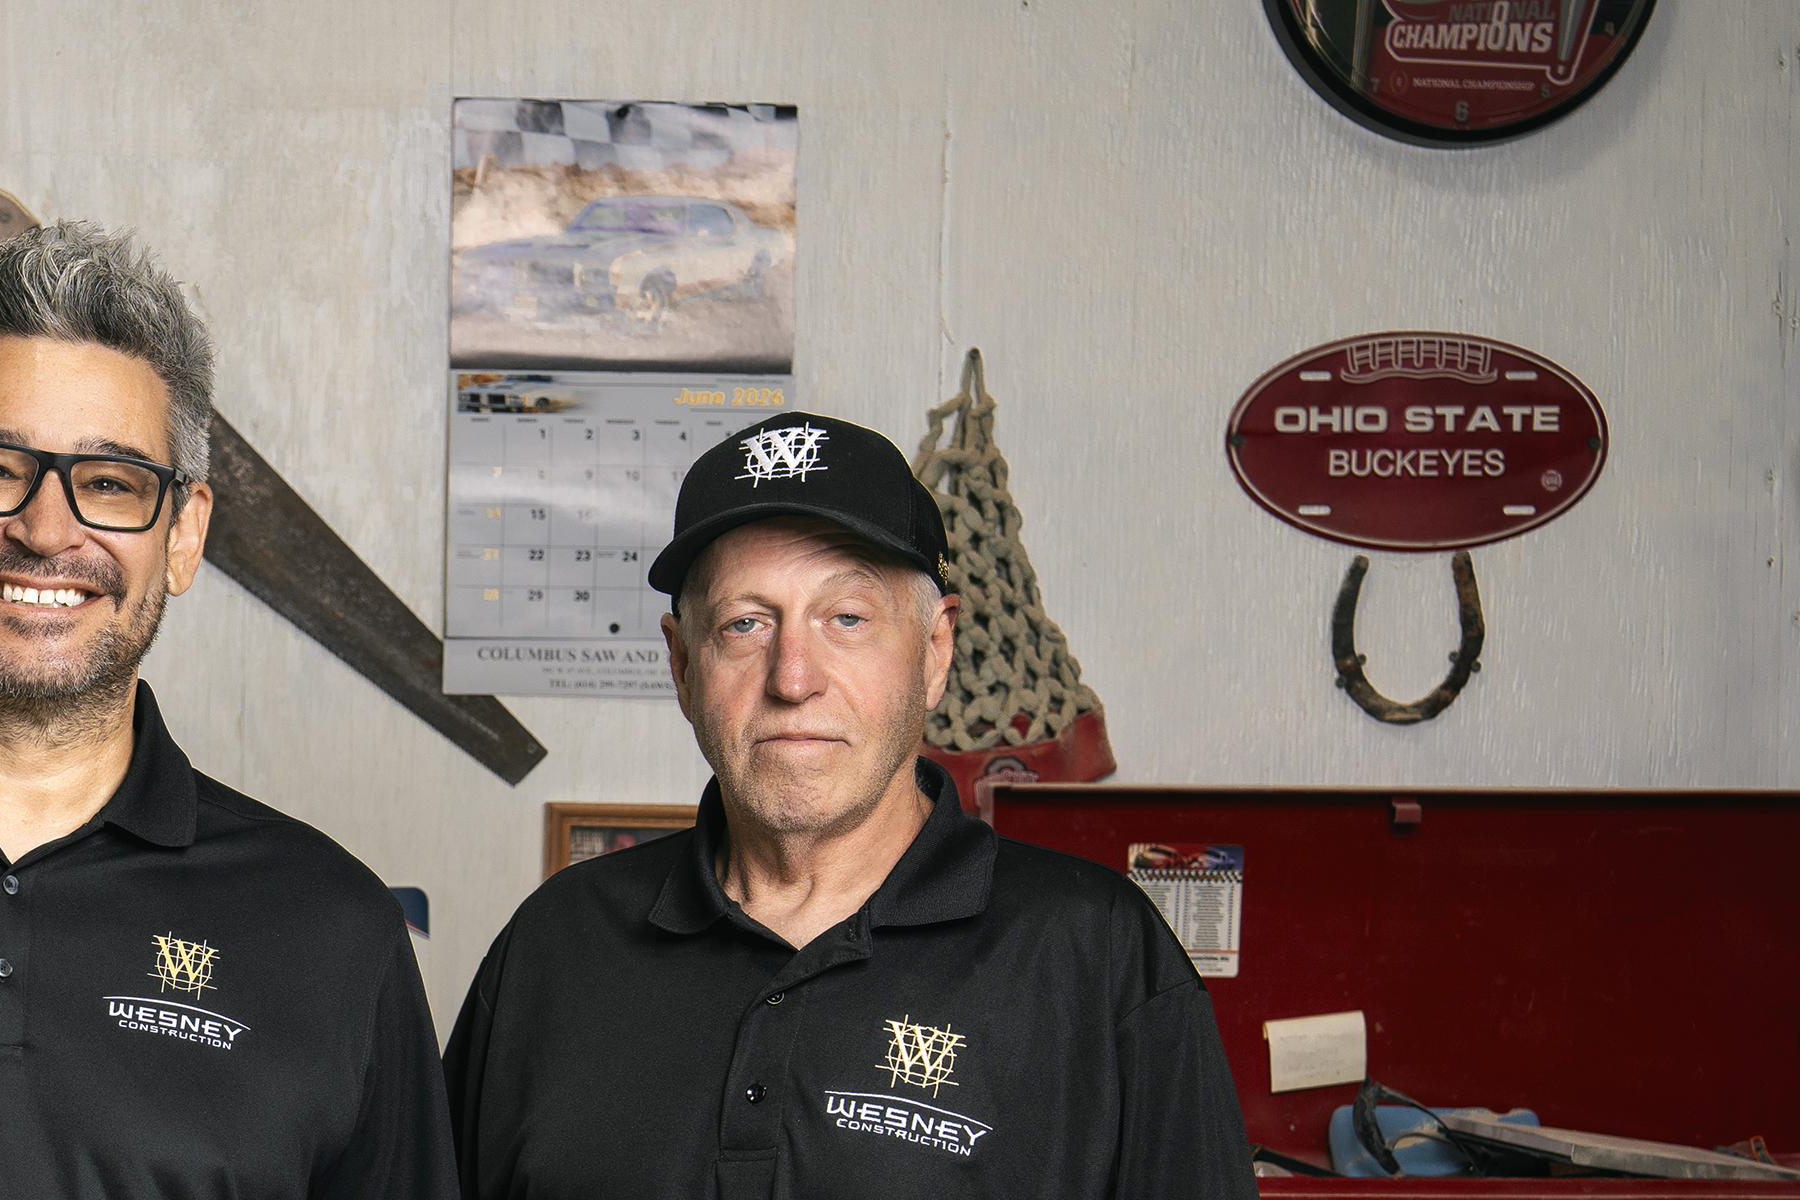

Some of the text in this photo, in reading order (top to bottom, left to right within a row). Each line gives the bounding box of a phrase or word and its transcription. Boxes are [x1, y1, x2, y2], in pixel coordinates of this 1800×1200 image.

[1391, 22, 1555, 53] CHAMPIONS
[1412, 76, 1537, 92] NATIONAL CHAMPIONSHIP
[1454, 100, 1471, 125] 6
[673, 387, 785, 406] June 2026
[1274, 405, 1562, 434] OHIO STATE
[584, 428, 595, 441] 2
[631, 429, 641, 442] 3
[677, 430, 688, 442] 4
[1328, 449, 1507, 477] BUCKEYES
[530, 508, 546, 521] 15
[528, 549, 545, 562] 22
[575, 550, 592, 562] 23
[621, 550, 638, 563] 24
[573, 590, 590, 602] 30
[477, 645, 577, 662] COLUMBUS
[580, 648, 616, 663] SAW
[621, 650, 660, 664] AND
[108, 1001, 243, 1042] WESNEY
[118, 1019, 233, 1051] CONSTRUCTION
[826, 1095, 988, 1147] WESNEY
[836, 1117, 972, 1157] CONSTRUCTION
